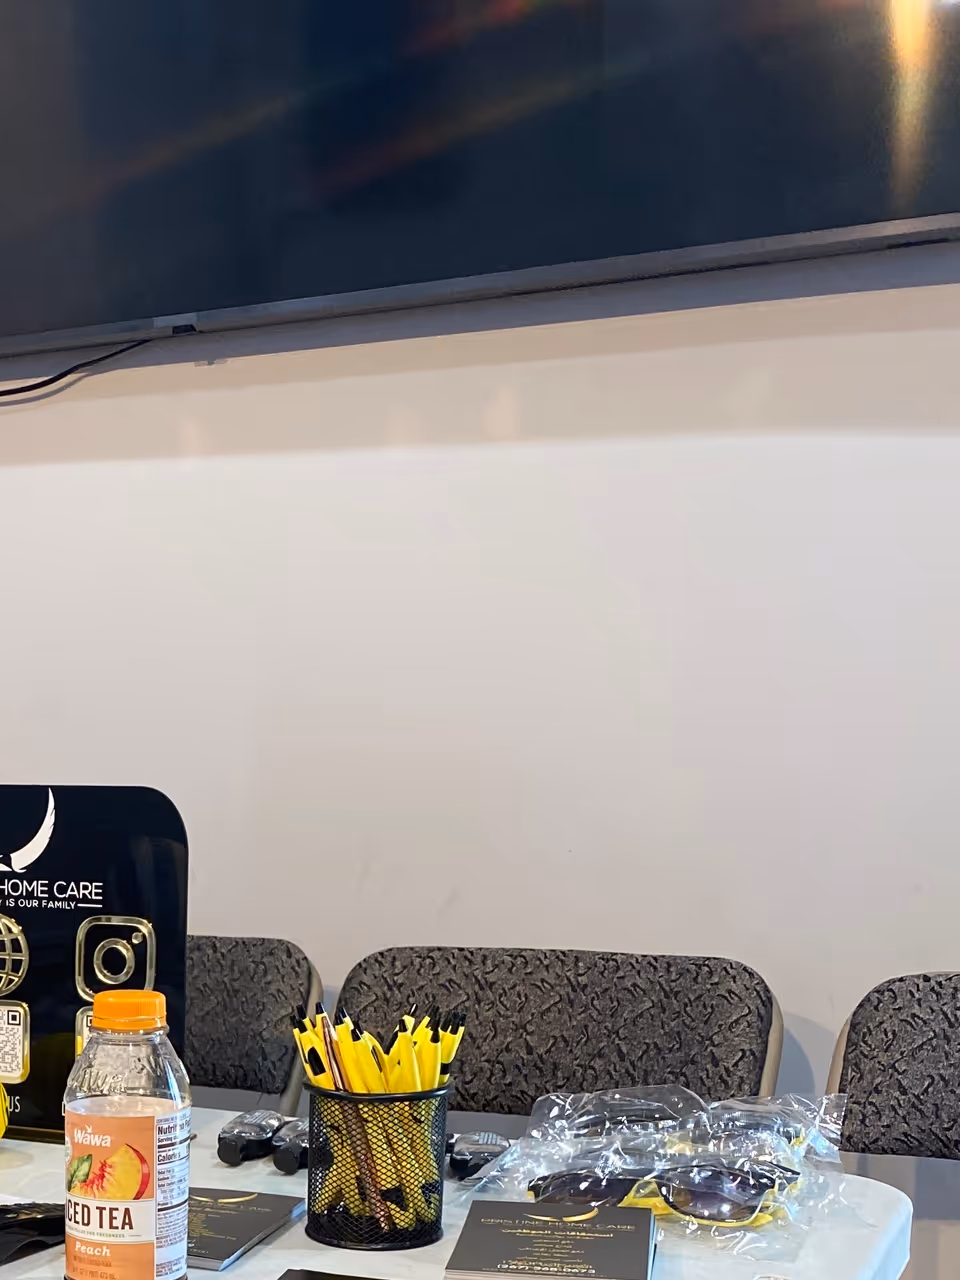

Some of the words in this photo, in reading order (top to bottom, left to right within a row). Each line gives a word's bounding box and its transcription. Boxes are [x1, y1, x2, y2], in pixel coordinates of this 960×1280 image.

[53, 881, 104, 900] CARE
[5, 898, 15, 907] IS
[18, 899, 39, 908] OUR
[42, 900, 76, 910] FAMILY
[74, 1128, 112, 1148] Wawa
[96, 1206, 134, 1231] TEA
[75, 1241, 111, 1256] Peach
